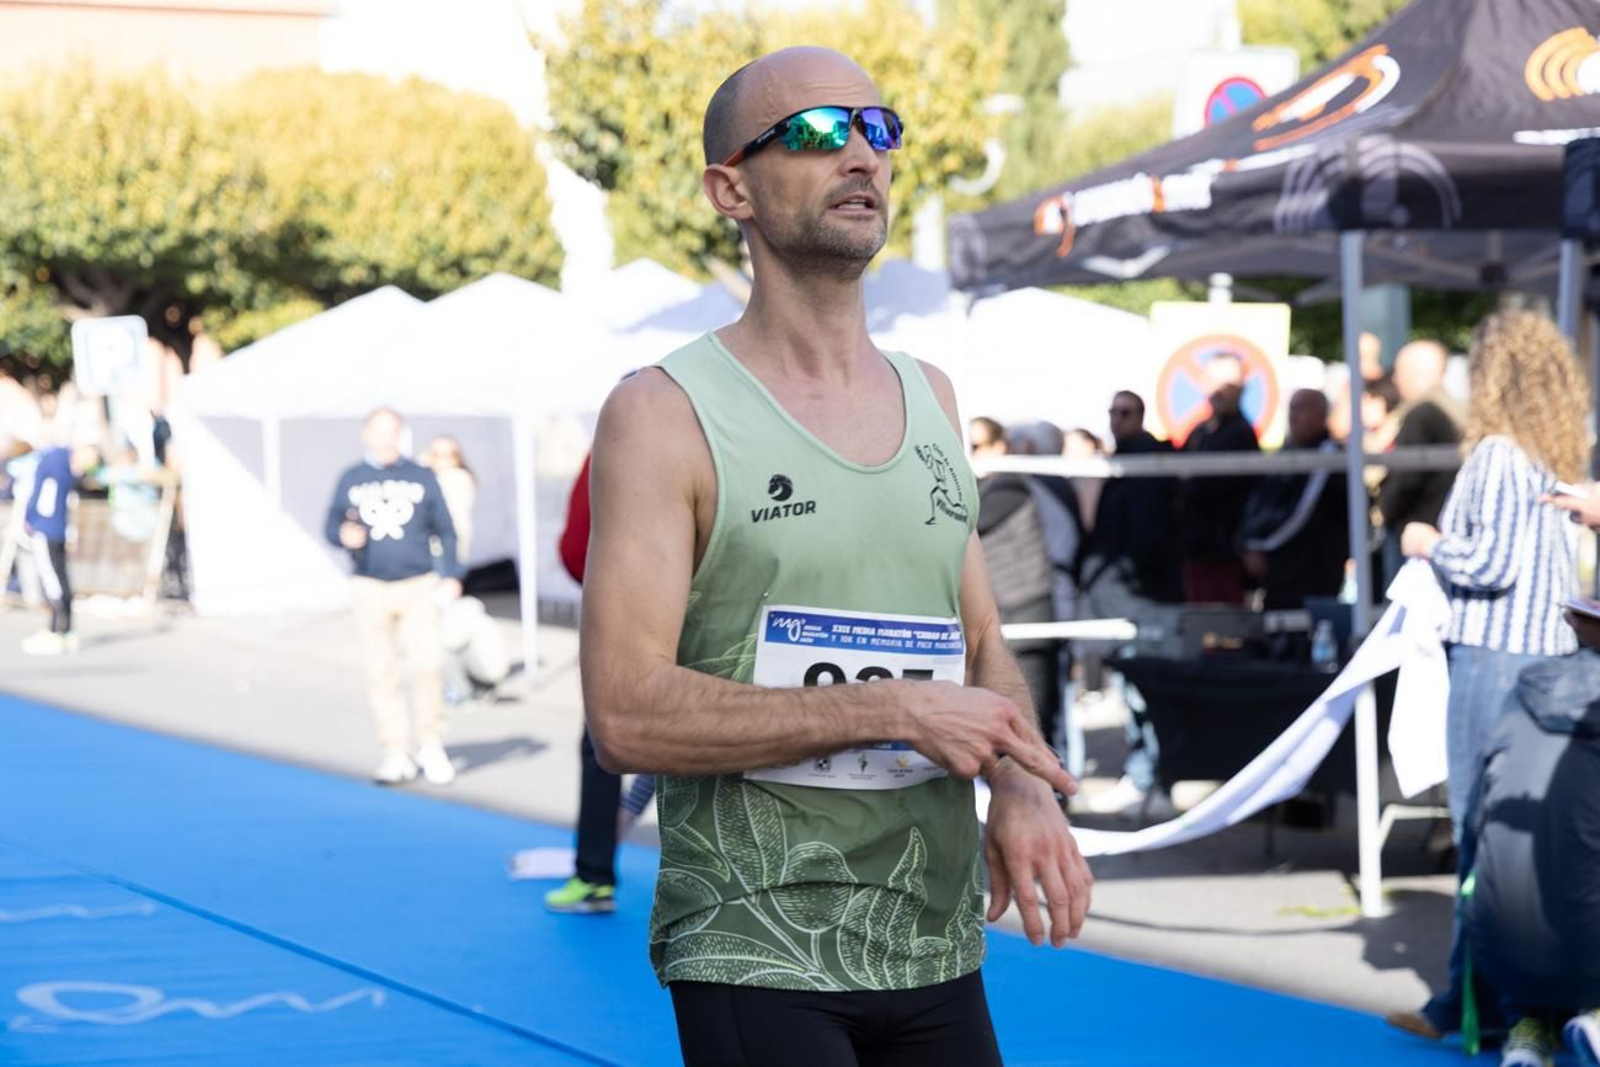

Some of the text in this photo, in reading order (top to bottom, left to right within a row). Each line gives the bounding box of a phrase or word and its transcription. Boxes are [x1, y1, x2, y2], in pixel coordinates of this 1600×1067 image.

[751, 500, 816, 523] VIATOR
[870, 638, 902, 647] MEMORIA
[905, 640, 913, 648] DE
